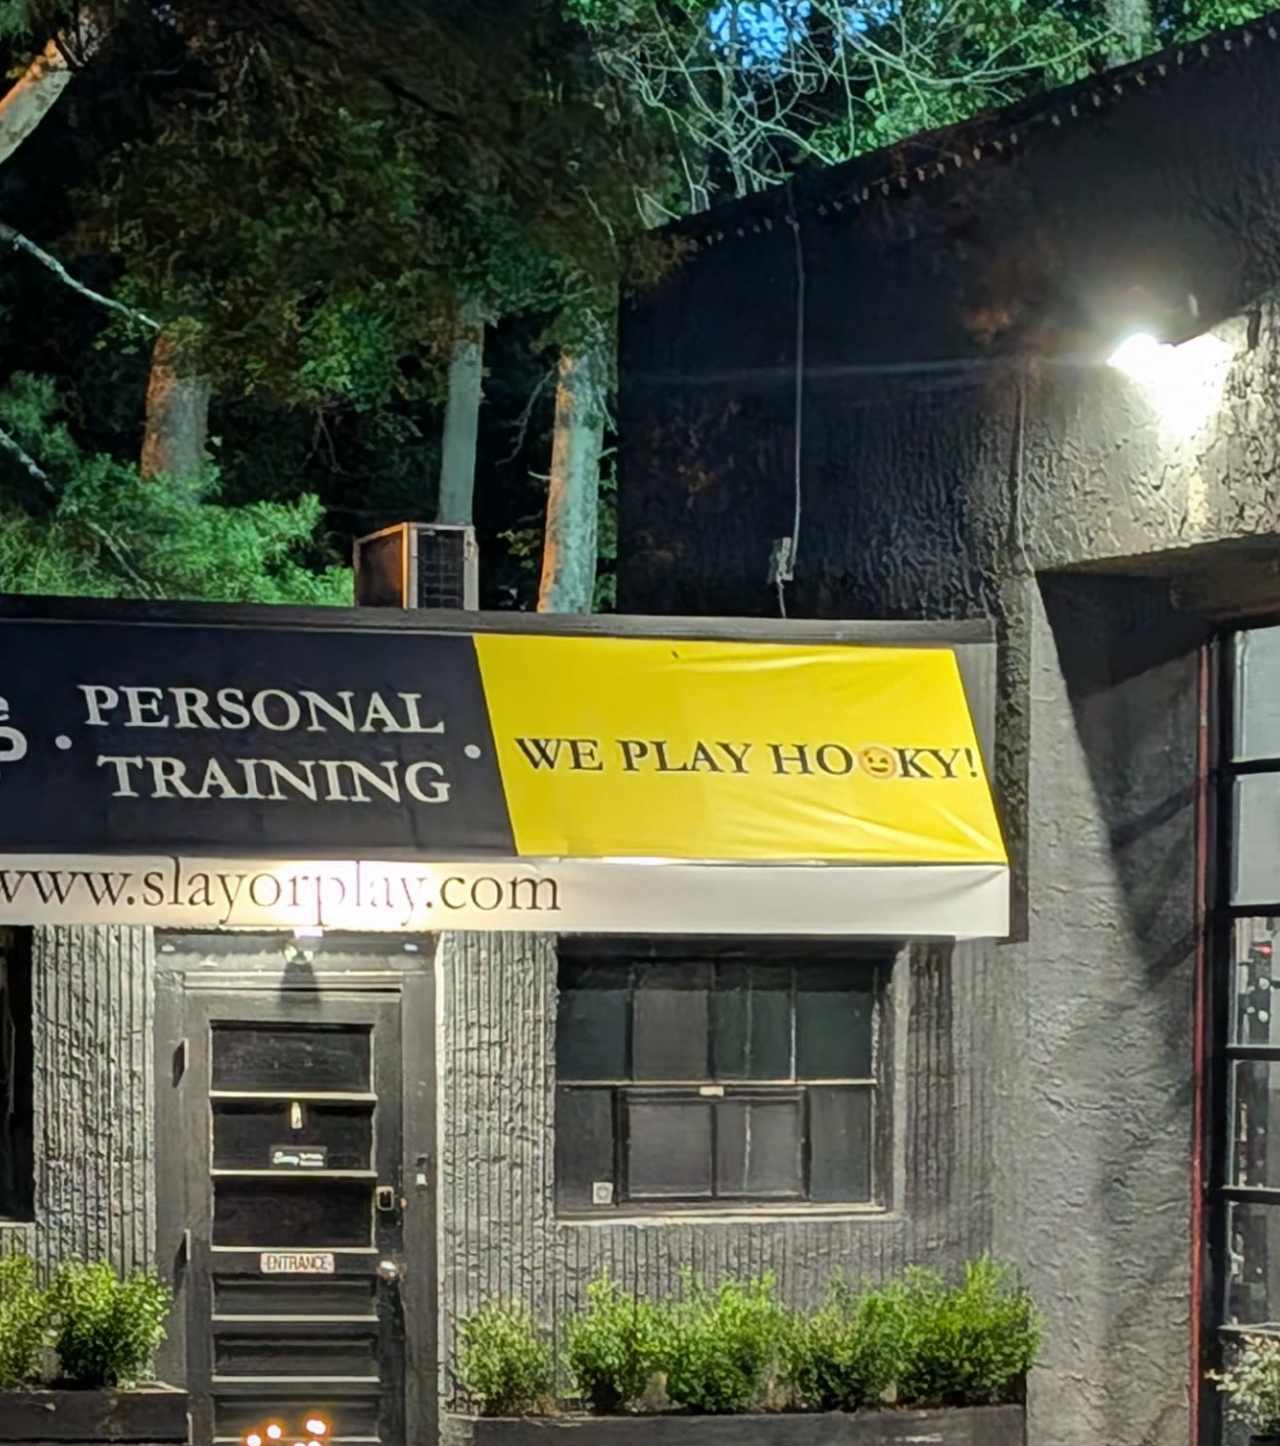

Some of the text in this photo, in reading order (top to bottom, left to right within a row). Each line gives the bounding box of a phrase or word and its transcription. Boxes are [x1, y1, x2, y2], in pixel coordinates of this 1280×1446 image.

[77, 684, 445, 735] PERSONAL
[513, 737, 604, 772] WE
[616, 739, 752, 774] PLAY
[96, 754, 451, 803] TRAINING
[266, 1254, 330, 1271] ENTRANCE
